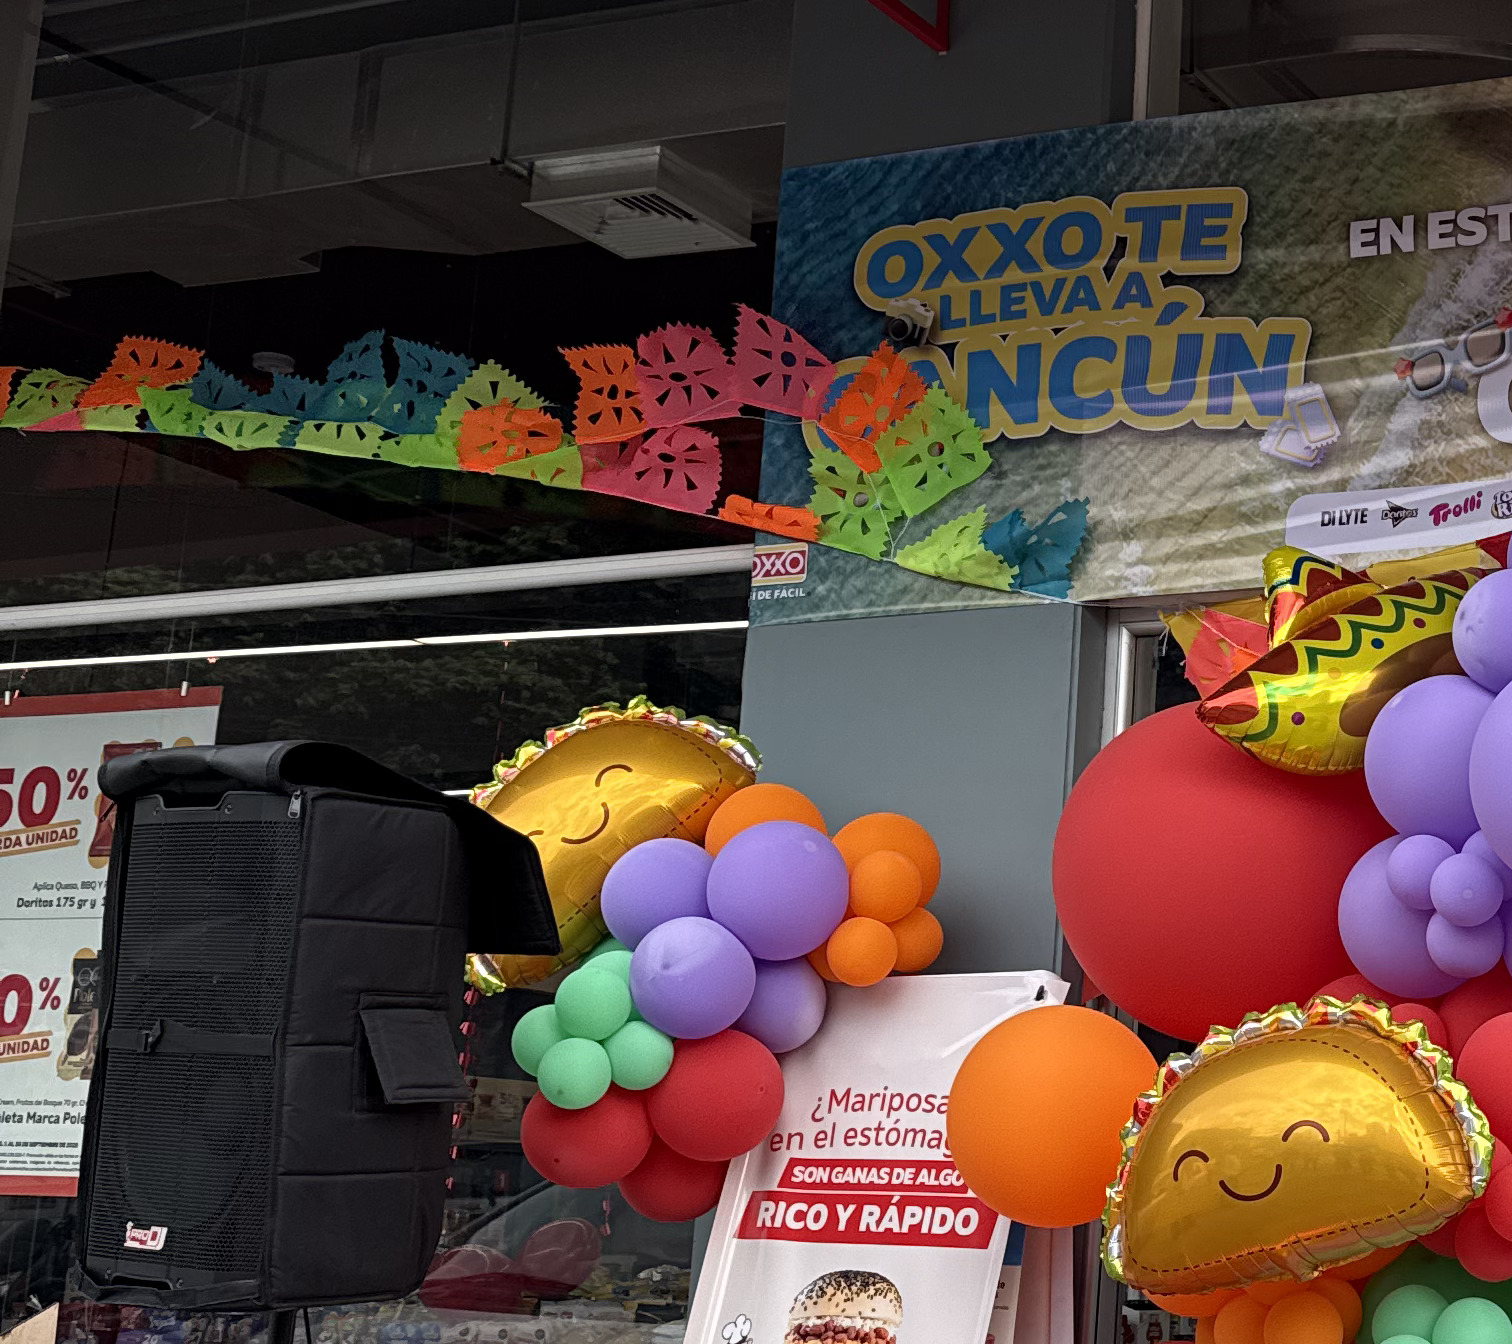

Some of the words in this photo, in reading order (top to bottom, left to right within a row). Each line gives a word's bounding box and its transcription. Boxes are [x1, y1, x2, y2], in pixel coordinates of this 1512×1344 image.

[865, 209, 1105, 301] OXXO
[1124, 202, 1235, 264] TE
[1348, 214, 1415, 259] EN
[939, 274, 1102, 332] LLEVA
[1111, 270, 1155, 311] A
[818, 300, 1297, 452] NCÚN
[1429, 491, 1483, 527] Trolli
[757, 589, 773, 600] DE
[774, 586, 806, 599] FÁCIL
[25, 827, 79, 846] UNIDAD
[16, 896, 54, 908] Doritos
[56, 897, 76, 908] 175
[77, 898, 89, 910] gr
[25, 1111, 61, 1125] Marca
[810, 1086, 951, 1123] ¿Mariposa
[769, 1131, 804, 1153] en
[812, 1122, 837, 1150] el
[790, 1165, 832, 1185] SON
[830, 1166, 891, 1186] GANAS
[890, 1167, 914, 1186] DE
[914, 1167, 967, 1187] ALGO
[755, 1200, 830, 1232] RICO
[835, 1202, 858, 1233] Y
[858, 1195, 980, 1237] RÁPIDO
